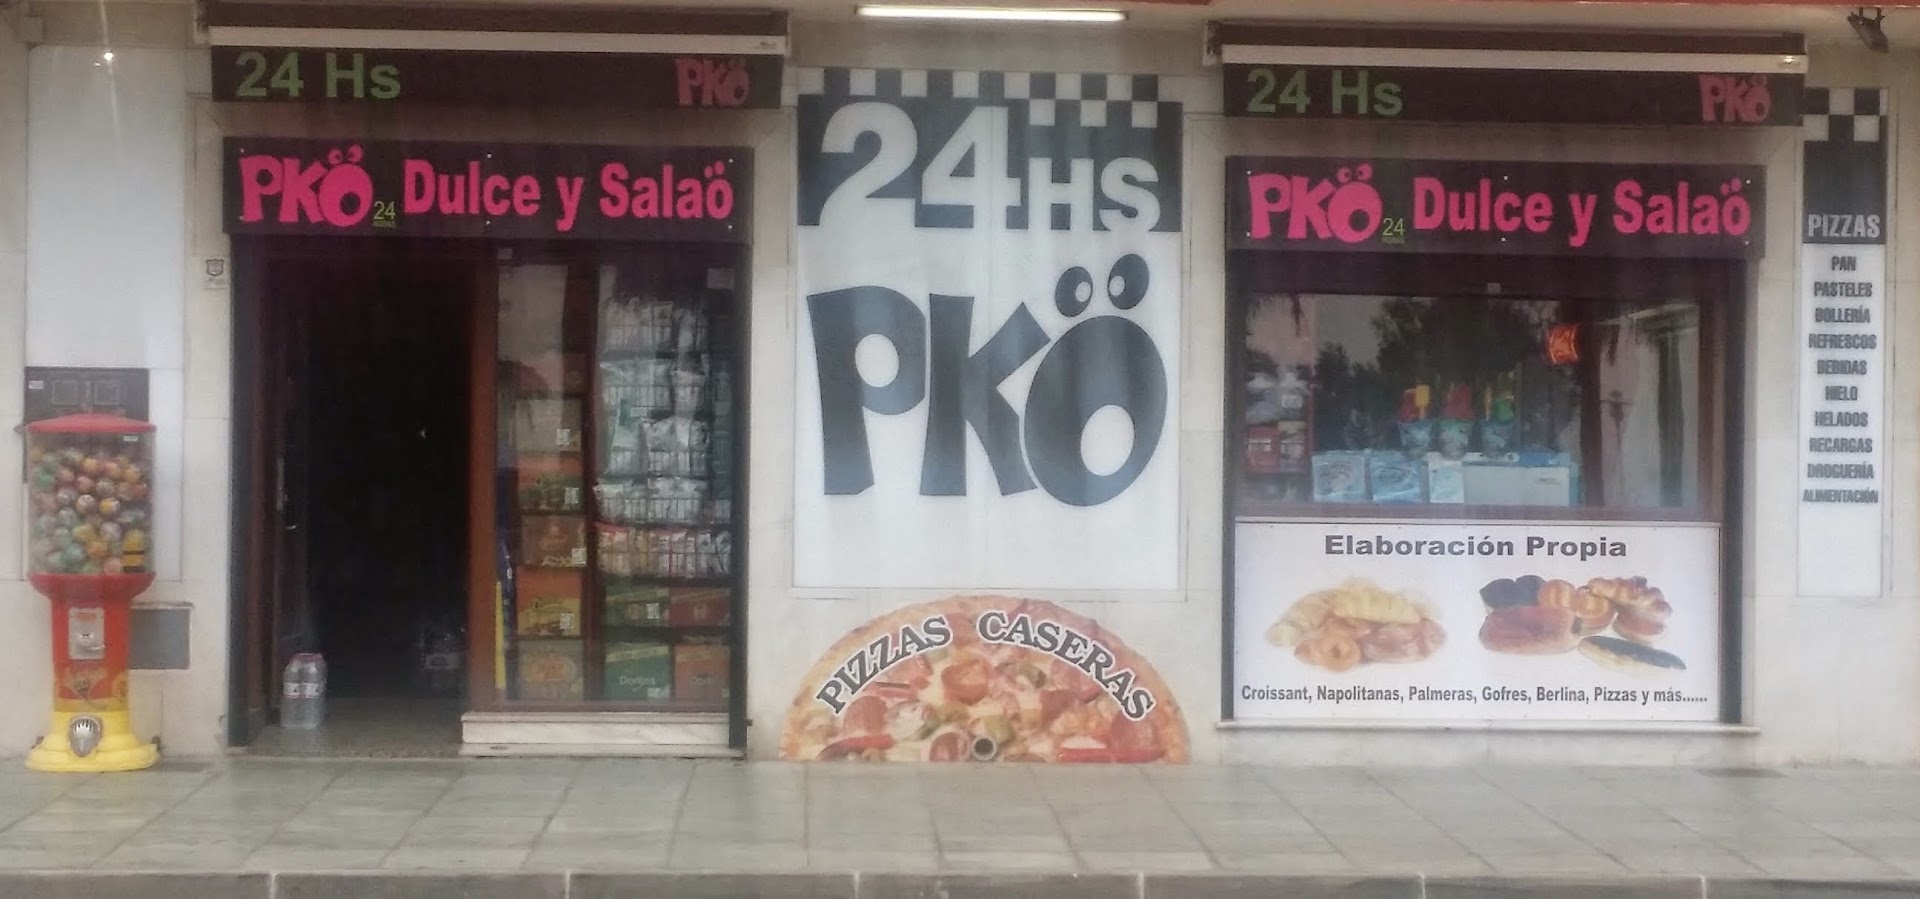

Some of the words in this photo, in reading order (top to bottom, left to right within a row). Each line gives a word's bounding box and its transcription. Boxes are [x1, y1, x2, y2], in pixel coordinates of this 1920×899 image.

[235, 52, 304, 97] 24
[325, 53, 400, 99] Hs
[1247, 69, 1311, 113] 24
[1331, 69, 1403, 116] Hs
[403, 159, 541, 216] Dulce
[556, 175, 584, 232] y
[373, 201, 396, 220] 24
[1413, 176, 1553, 234] Dulce
[1568, 194, 1597, 248] y
[1382, 217, 1405, 236] 24
[1808, 214, 1881, 238] PIZZAS
[1831, 256, 1857, 271] PAN
[1814, 281, 1873, 298] PASTELES
[1815, 305, 1871, 323] BOLLERÍA
[1808, 333, 1877, 350] REFRESCOS
[1817, 359, 1867, 375] BEBIDAS
[1825, 386, 1858, 401] HIELO
[1814, 411, 1869, 427] HELADOS
[1809, 437, 1873, 453] RECARGAS
[1807, 461, 1874, 479] DROGUERÍA
[1802, 487, 1878, 503] ALIMENTACIÓN
[1324, 535, 1514, 556] Elaboración
[1526, 536, 1627, 561] Propia
[816, 615, 952, 713] PIZZAS
[978, 611, 1154, 720] CASERAS
[1241, 685, 1312, 703] Croissant,
[1317, 685, 1404, 704] Napolitanas,
[1409, 686, 1477, 704] Palmeras,
[1482, 686, 1532, 704] Gofres,
[1537, 686, 1589, 704] Berlina,
[1594, 687, 1637, 702] Pizzas
[1642, 689, 1649, 706] y
